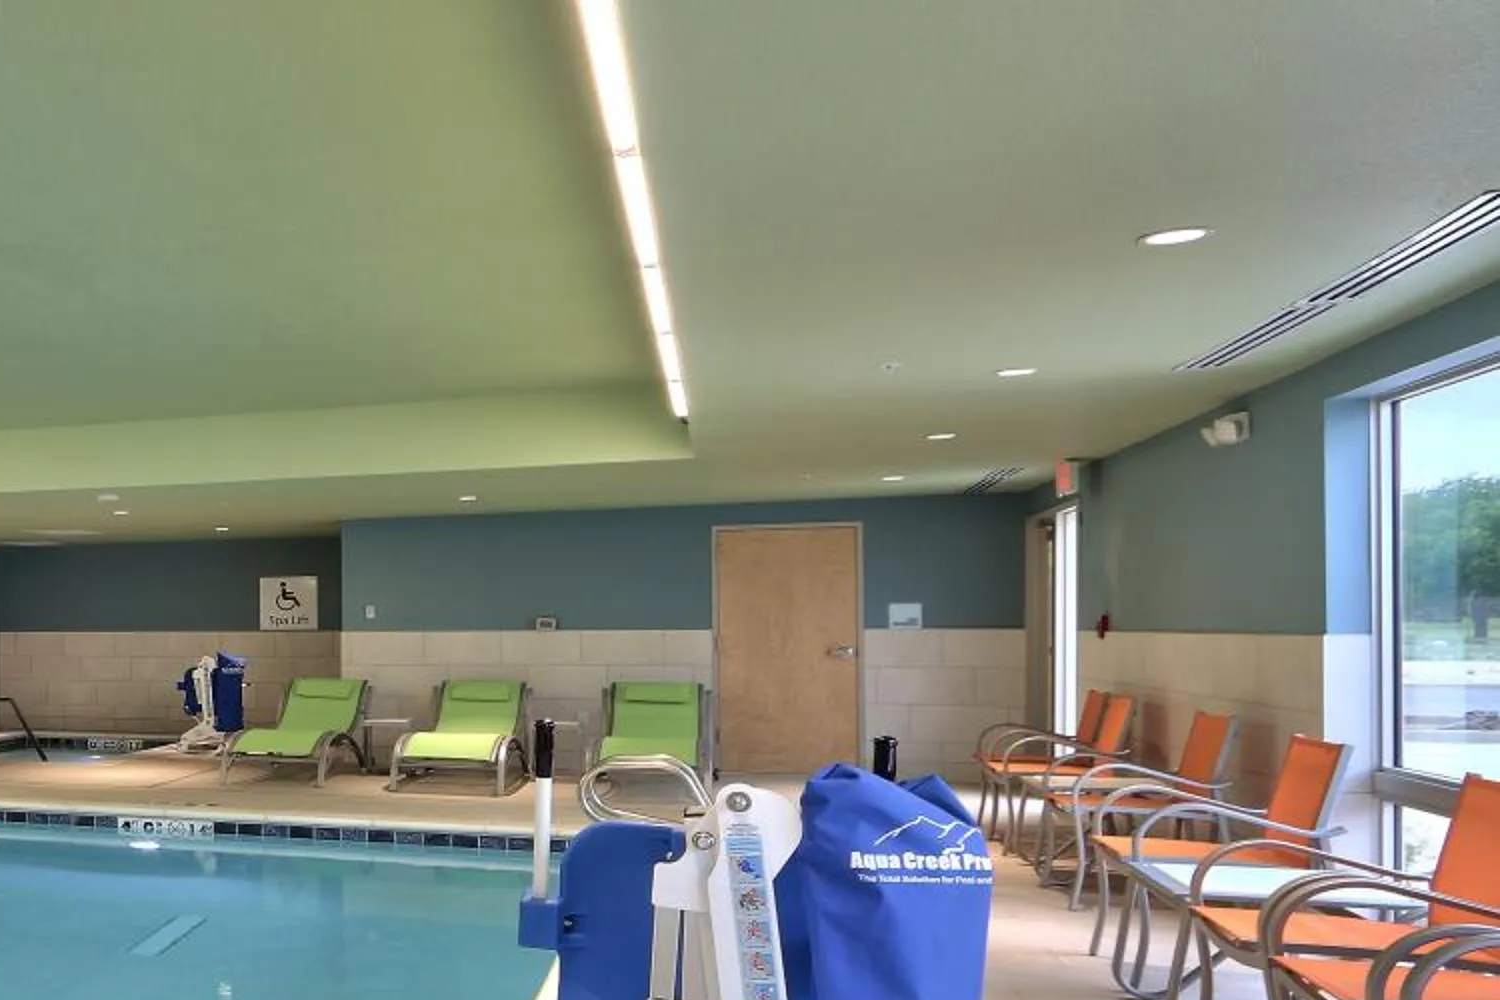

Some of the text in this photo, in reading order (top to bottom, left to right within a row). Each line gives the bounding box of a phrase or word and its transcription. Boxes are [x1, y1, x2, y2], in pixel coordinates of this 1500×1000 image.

[851, 851, 901, 871] Aqua
[903, 851, 963, 870] Creek
[858, 873, 877, 883] The
[879, 874, 901, 883] Total
[902, 875, 940, 884] Solution
[942, 874, 955, 883] for
[955, 875, 975, 884] Pool
